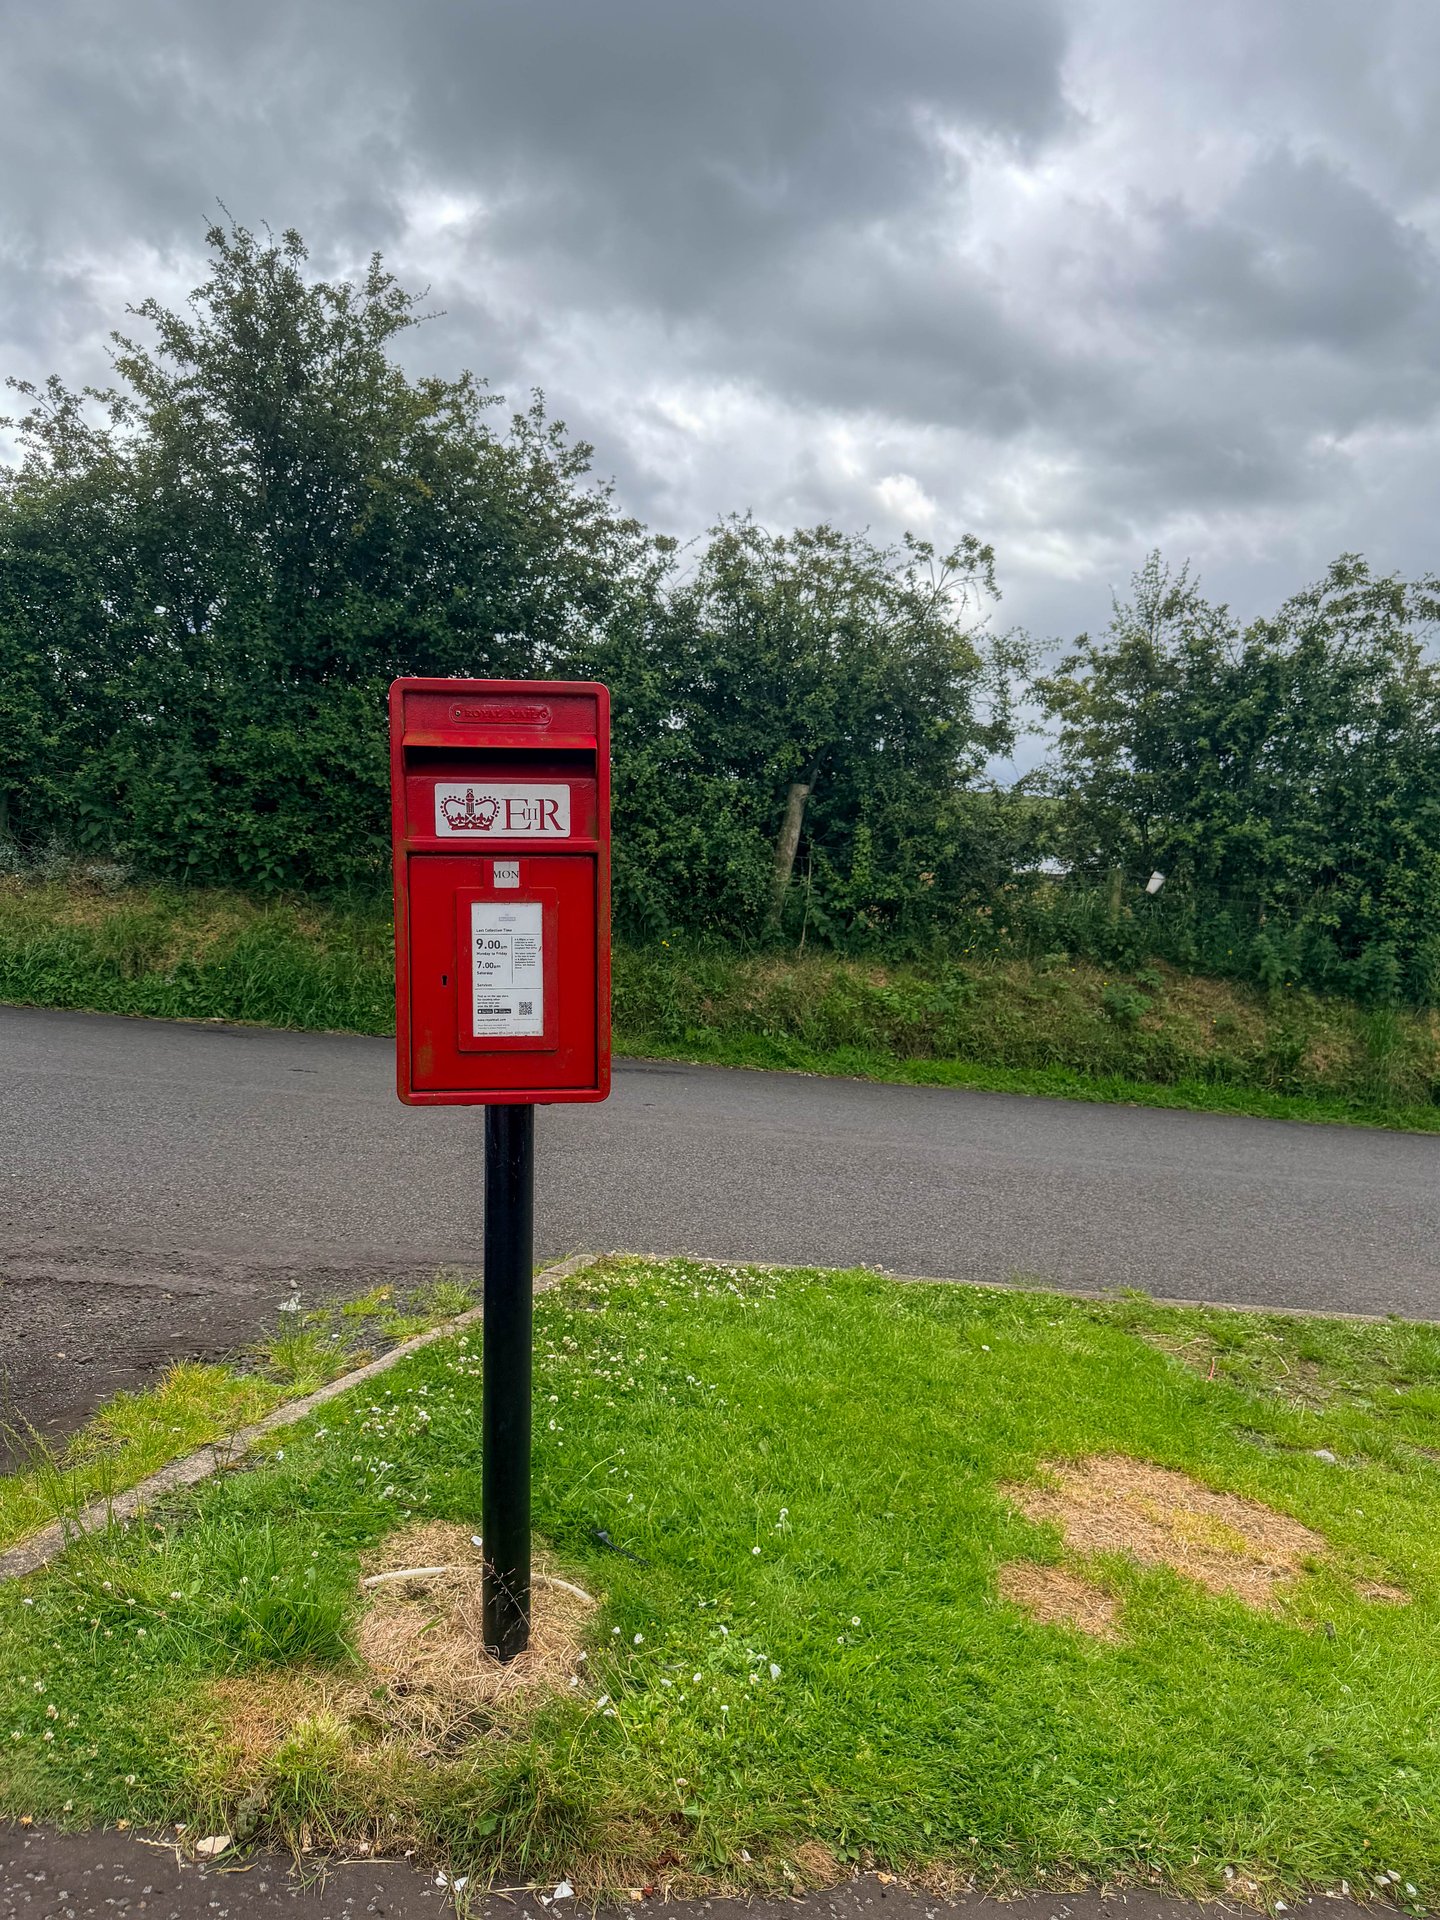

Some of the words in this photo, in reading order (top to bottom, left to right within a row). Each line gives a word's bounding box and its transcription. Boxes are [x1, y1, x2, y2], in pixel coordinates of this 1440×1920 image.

[464, 709, 503, 719] ROYAL
[509, 709, 539, 719] MAIL
[494, 870, 519, 879] MON
